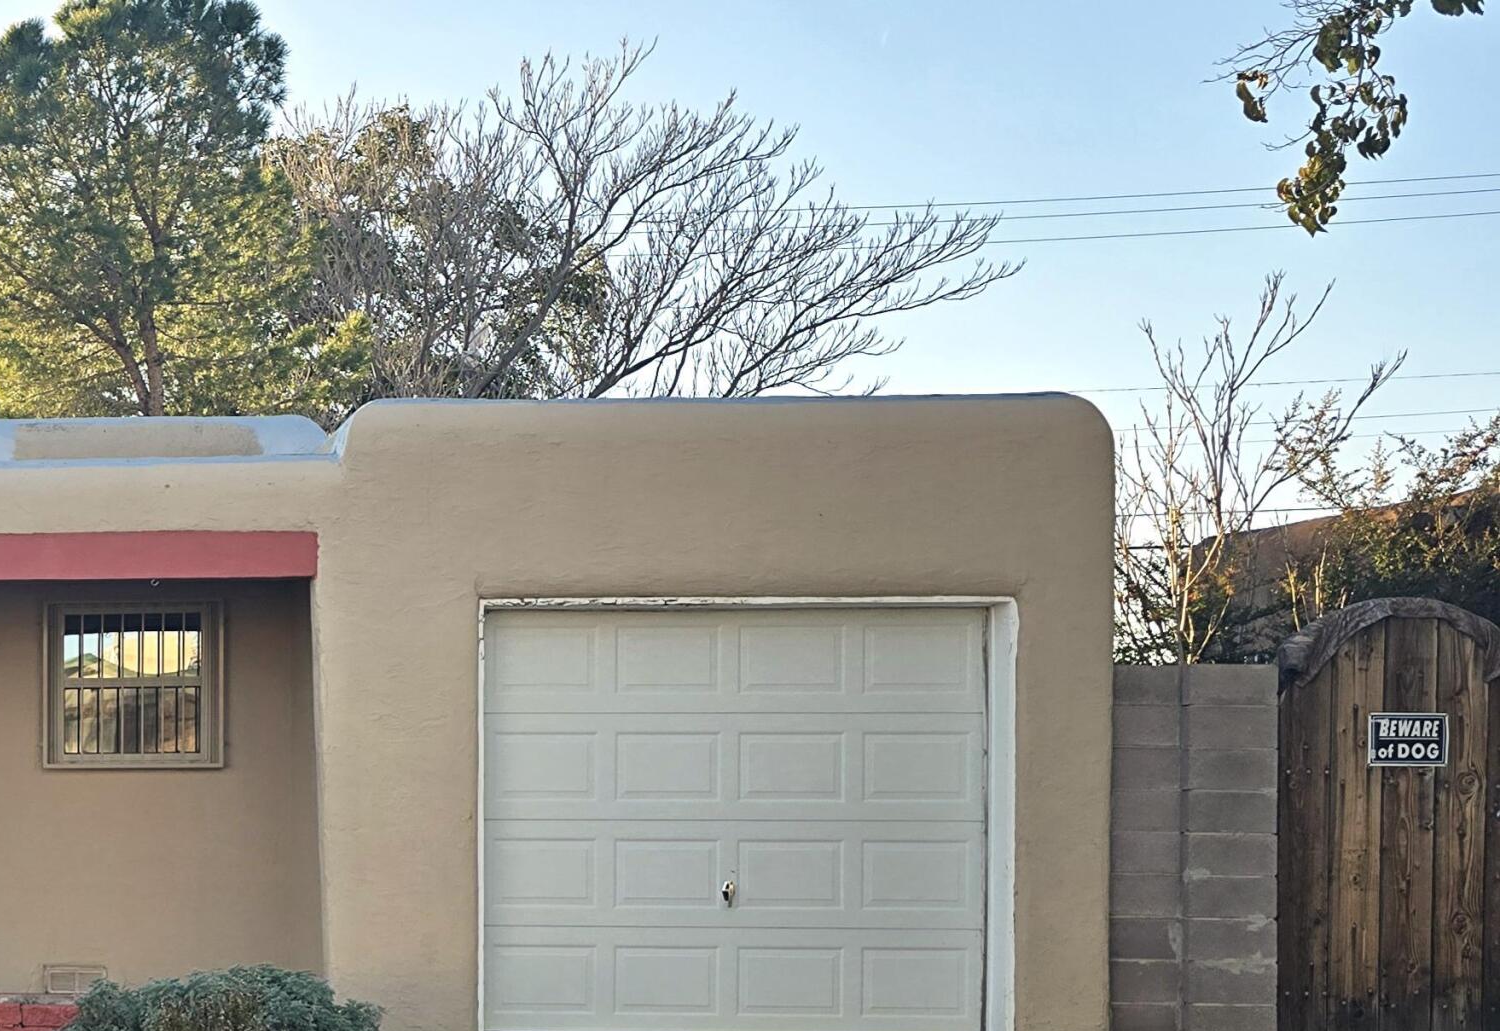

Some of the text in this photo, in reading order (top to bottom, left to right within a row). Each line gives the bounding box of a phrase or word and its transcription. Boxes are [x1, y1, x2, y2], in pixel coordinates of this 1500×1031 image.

[1379, 719, 1440, 737] BEWARE
[1378, 743, 1439, 759] of DOG
